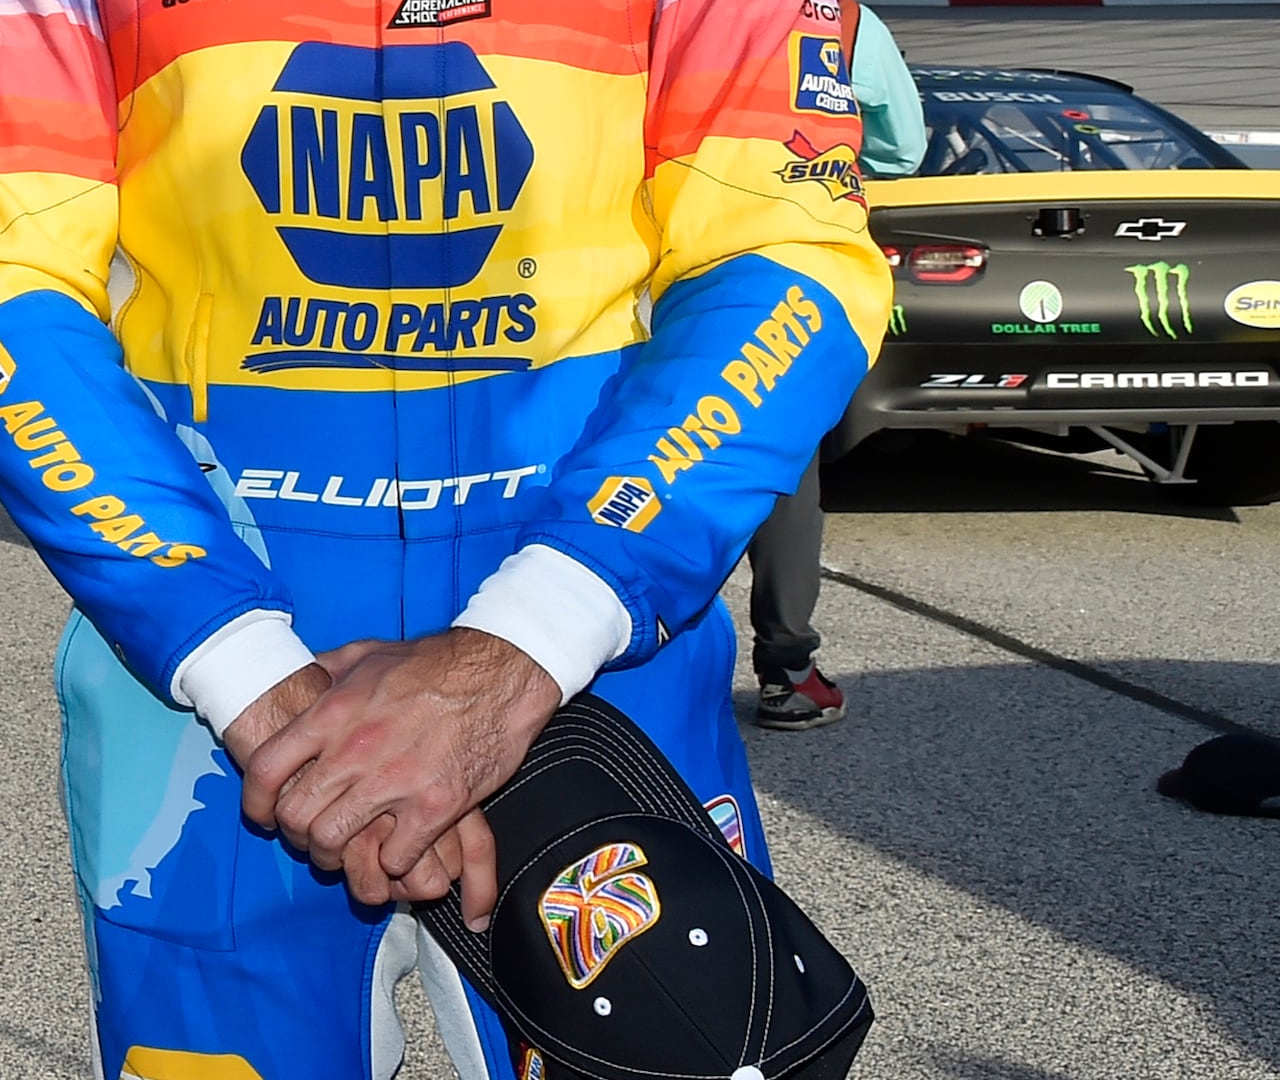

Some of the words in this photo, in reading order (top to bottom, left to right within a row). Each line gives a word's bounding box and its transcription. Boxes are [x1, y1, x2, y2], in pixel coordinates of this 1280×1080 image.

[395, 11, 438, 24] SHOC
[933, 92, 1063, 104] BUSCH
[290, 105, 492, 222] NAPA
[251, 296, 380, 351] AUTO
[384, 293, 538, 352] PARTS
[992, 323, 1056, 334] DOLLAR
[1060, 323, 1101, 333] TREE
[721, 285, 823, 408] PARTS
[1047, 372, 1269, 388] CAMARO
[647, 395, 742, 485] AUTO
[234, 465, 537, 510] ELLIOTT
[598, 482, 651, 528] NAPA
